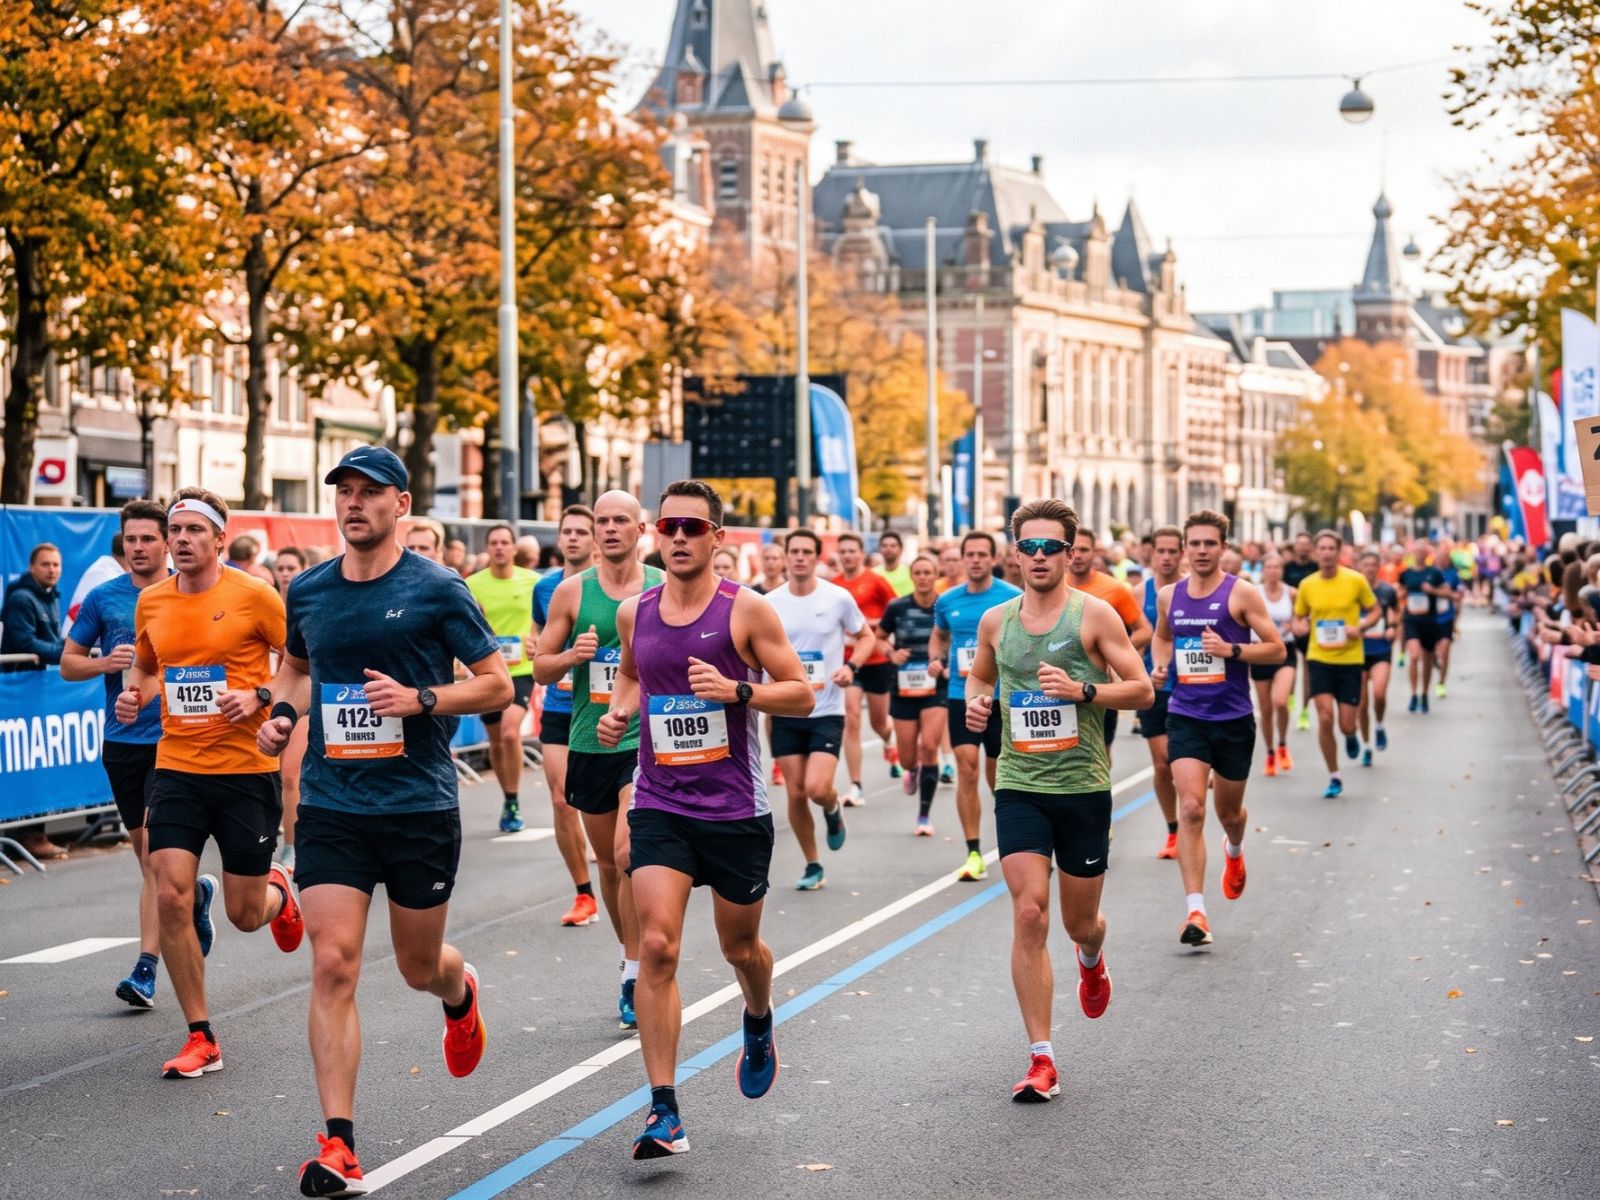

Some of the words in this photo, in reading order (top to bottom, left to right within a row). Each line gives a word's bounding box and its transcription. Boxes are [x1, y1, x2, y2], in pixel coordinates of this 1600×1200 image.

[1184, 652, 1213, 665] 1045
[177, 685, 213, 702] 4125
[336, 707, 383, 728] 4125
[664, 716, 709, 737] 1089
[1022, 709, 1062, 727] 1089
